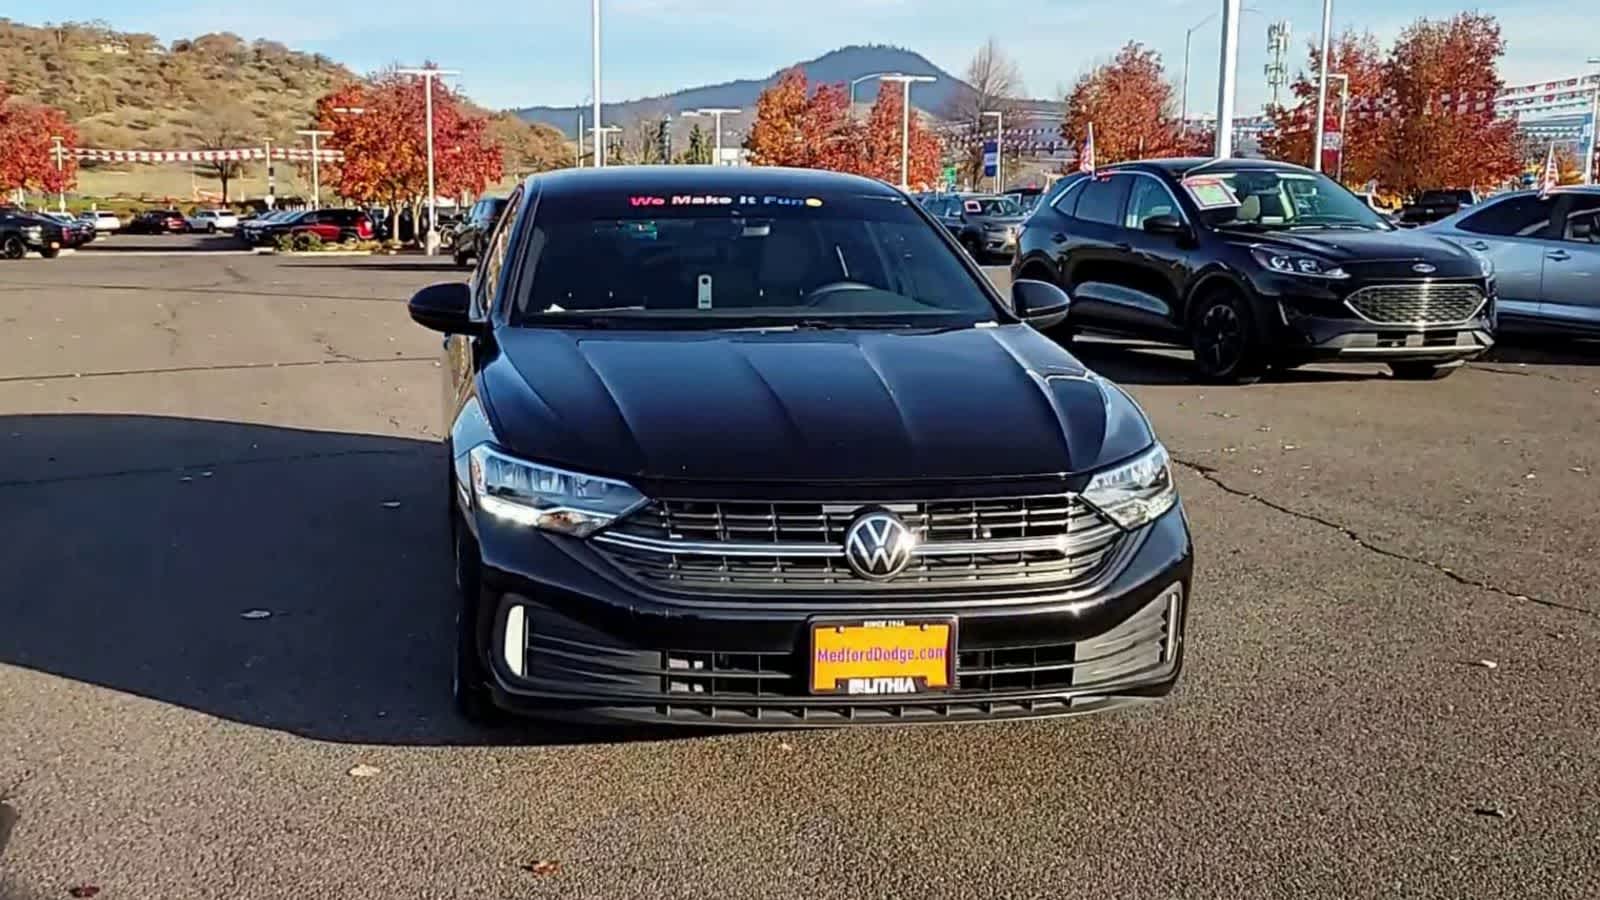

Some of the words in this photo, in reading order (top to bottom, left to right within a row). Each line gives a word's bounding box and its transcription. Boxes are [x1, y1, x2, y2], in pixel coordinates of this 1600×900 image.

[630, 196, 665, 206] We
[671, 195, 733, 205] Make
[739, 195, 756, 205] It
[763, 196, 804, 206] Fun
[817, 646, 947, 663] MedfordDodge.com
[865, 677, 916, 694] LITHIA
